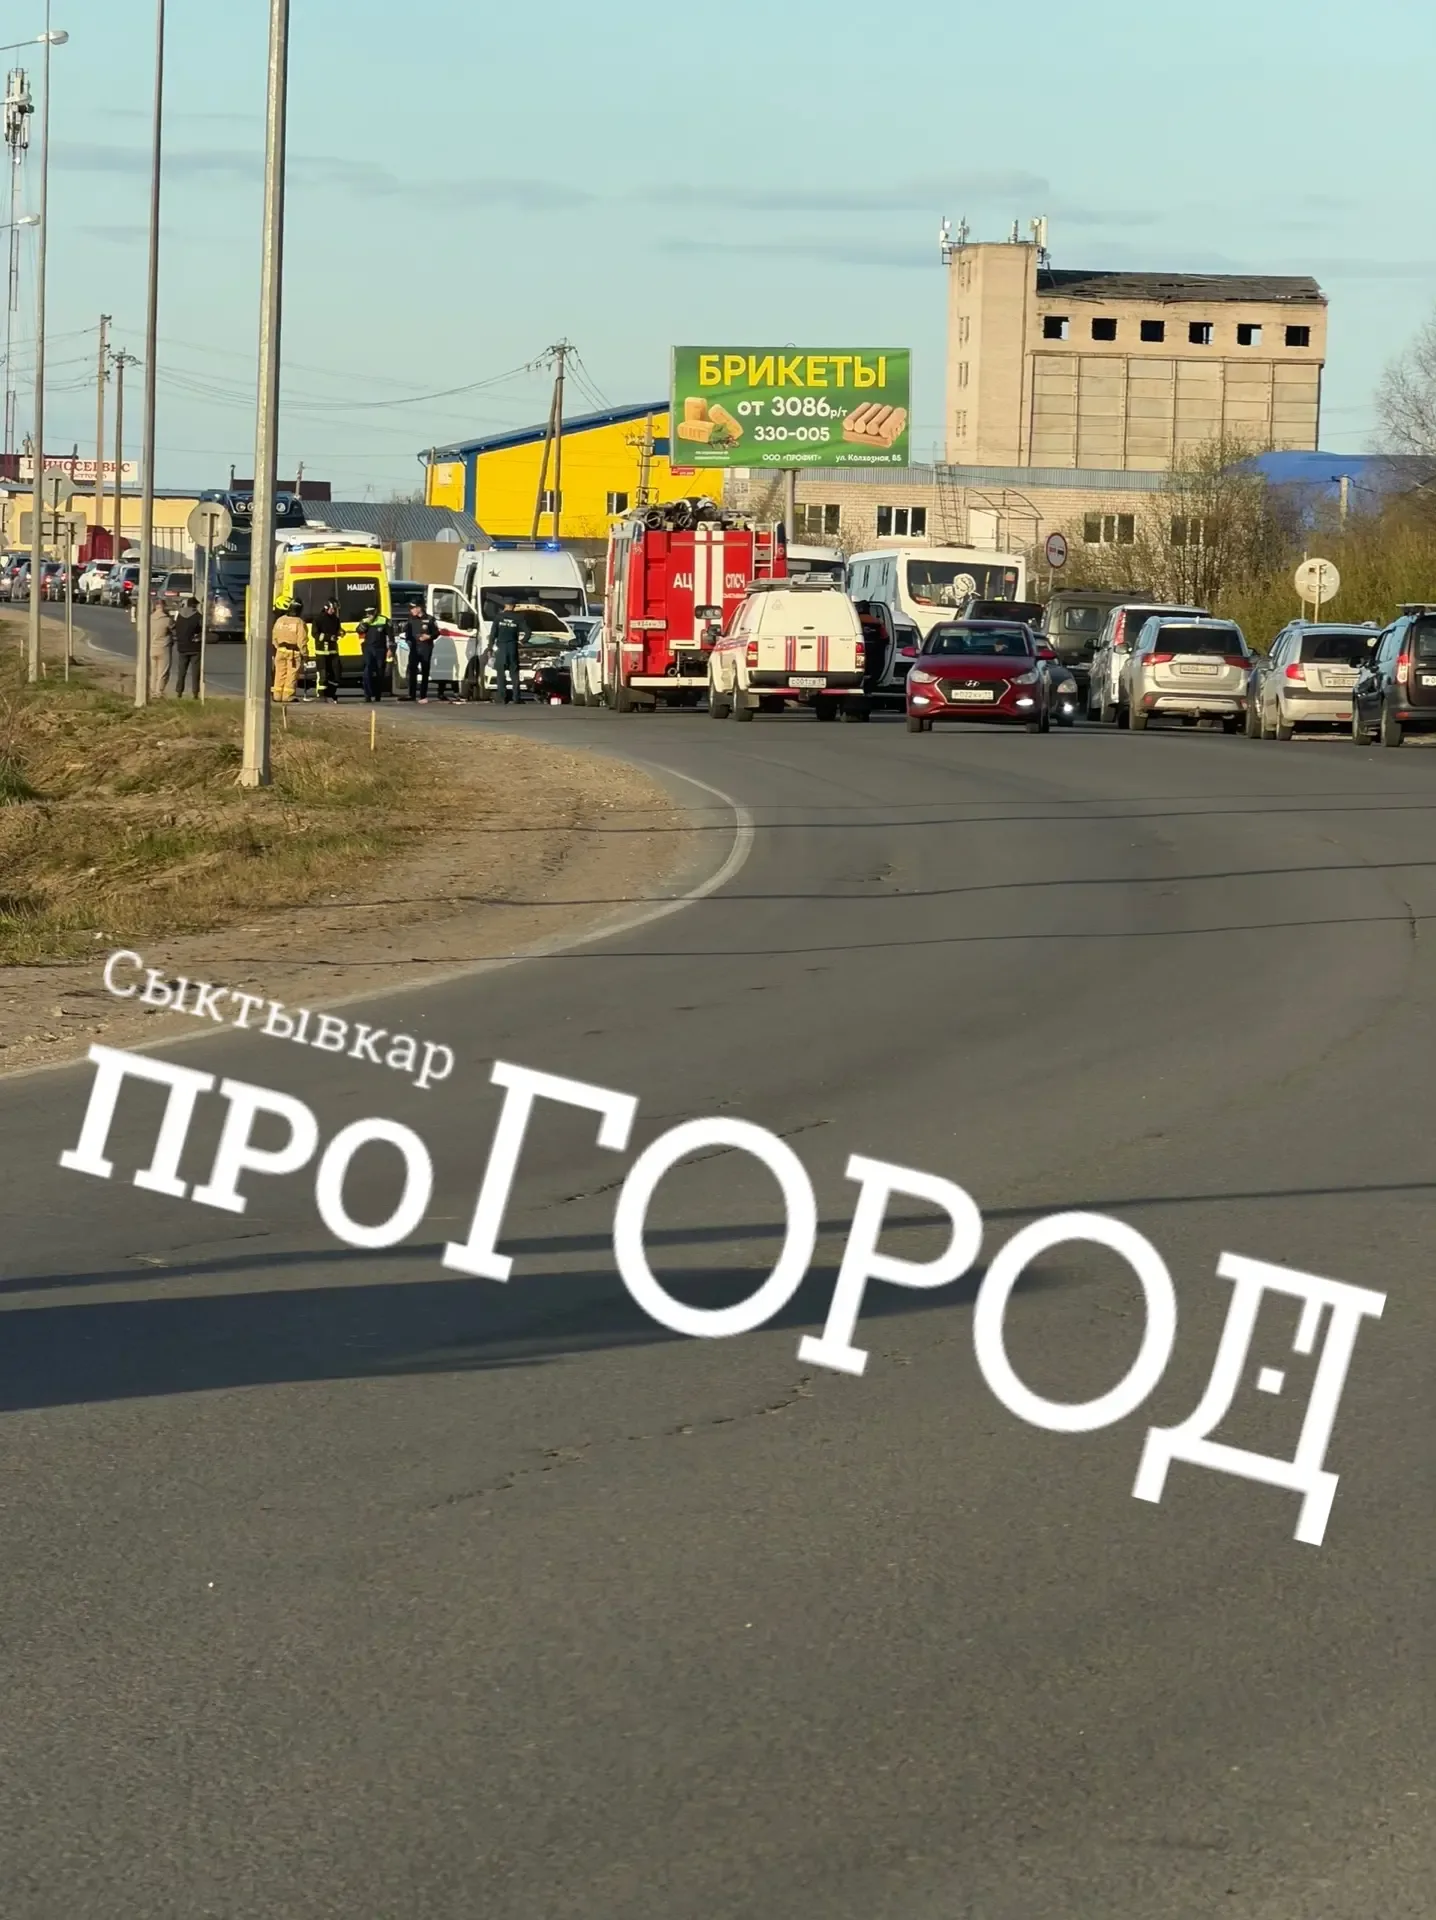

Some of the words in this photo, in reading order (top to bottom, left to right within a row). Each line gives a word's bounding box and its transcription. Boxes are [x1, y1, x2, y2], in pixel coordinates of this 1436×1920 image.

[700, 354, 886, 388] БРИКЕТЫ
[737, 401, 764, 416] от
[754, 426, 830, 441] 330-005
[762, 454, 781, 462] ООО
[835, 454, 846, 463] ул.
[347, 583, 376, 591] НАШИХ
[673, 573, 693, 591] АЦ
[725, 573, 745, 589] СПСЧ
